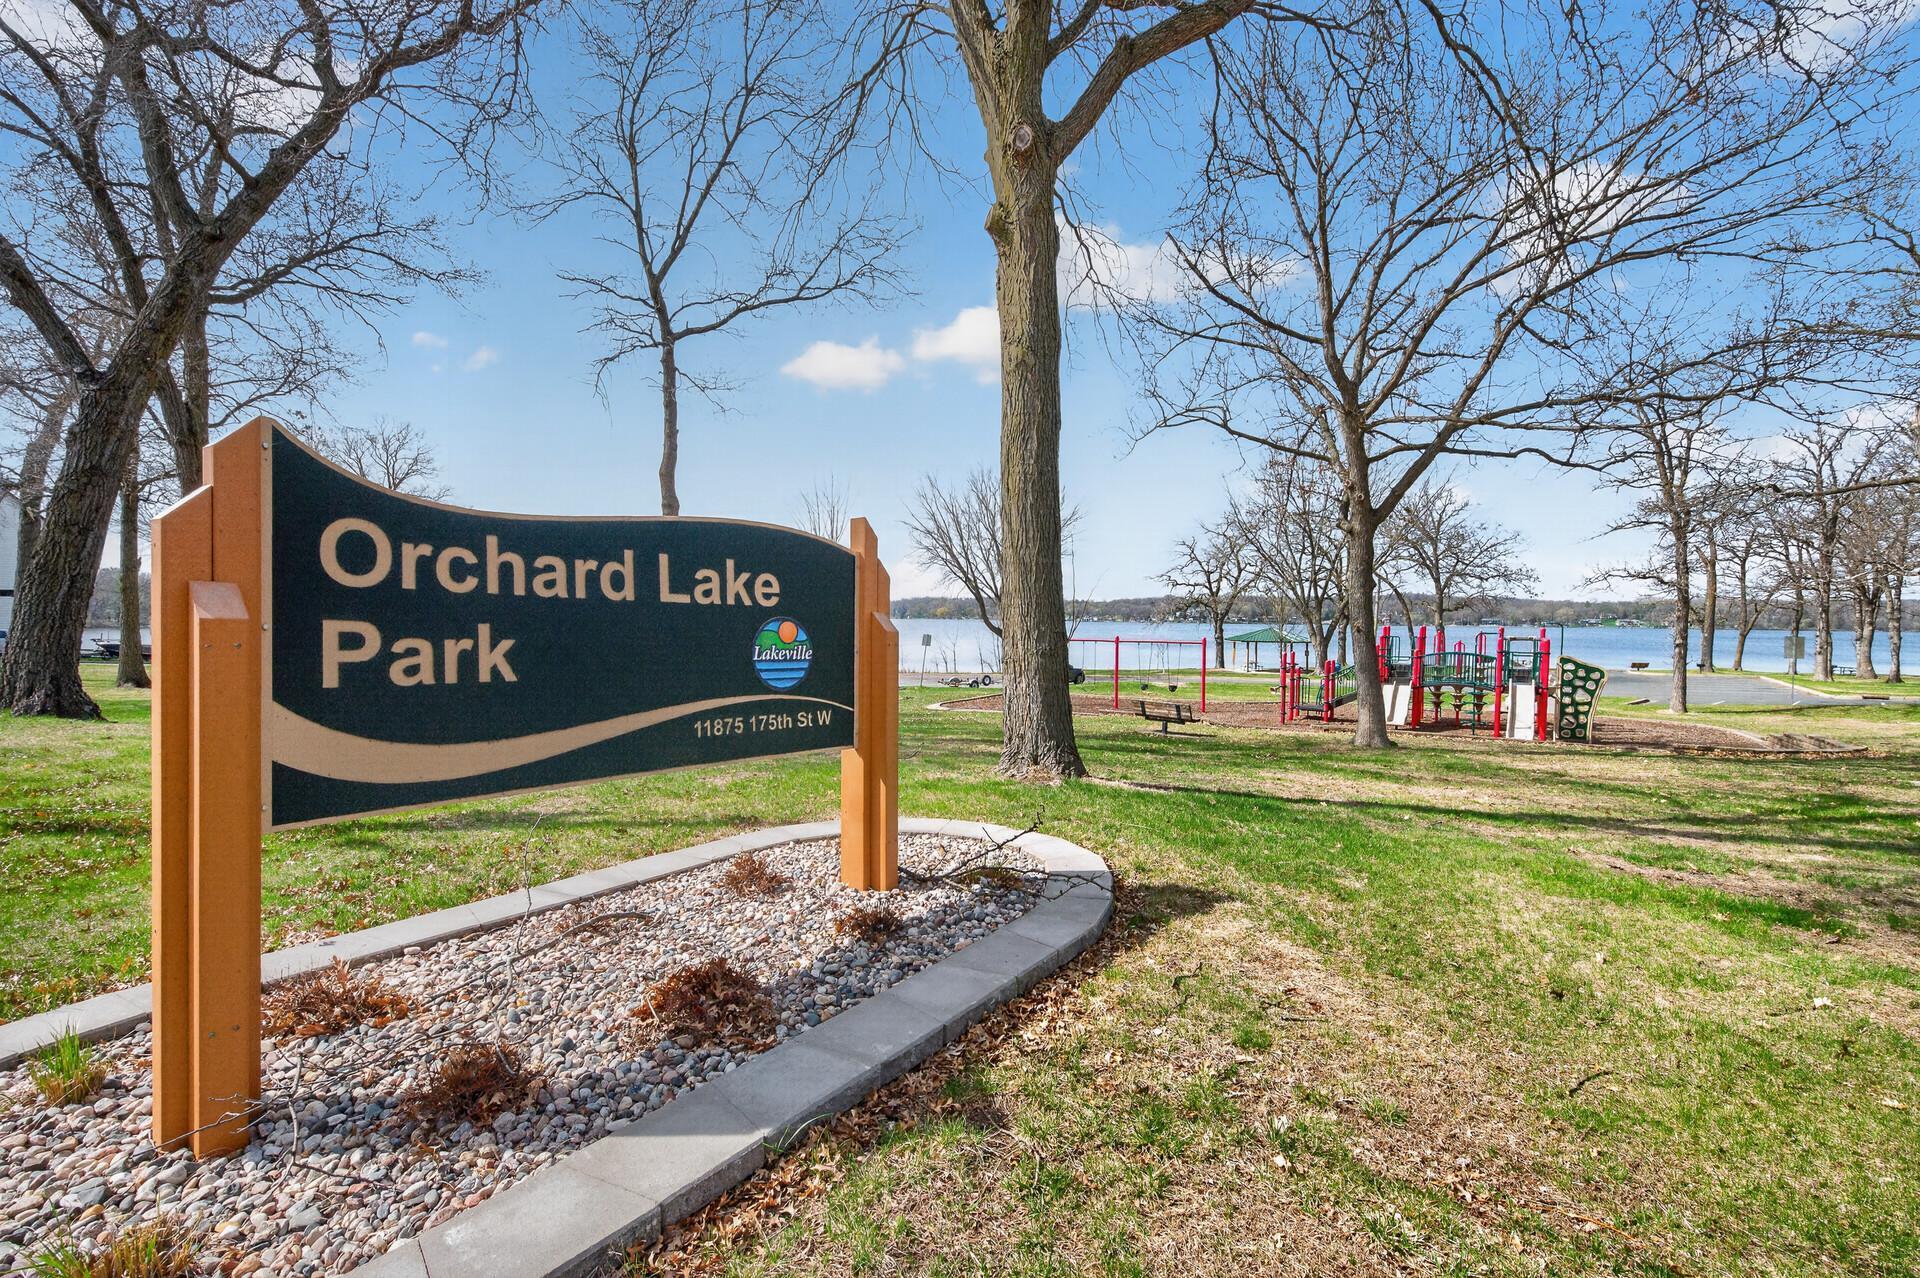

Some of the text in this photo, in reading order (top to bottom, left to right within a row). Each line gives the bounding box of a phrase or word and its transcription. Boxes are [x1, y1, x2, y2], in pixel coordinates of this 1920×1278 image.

[319, 517, 781, 607] Orchard Lake
[321, 618, 518, 689] Park
[753, 645, 813, 661] Lakeville
[694, 709, 832, 738] 11875 175th St W
